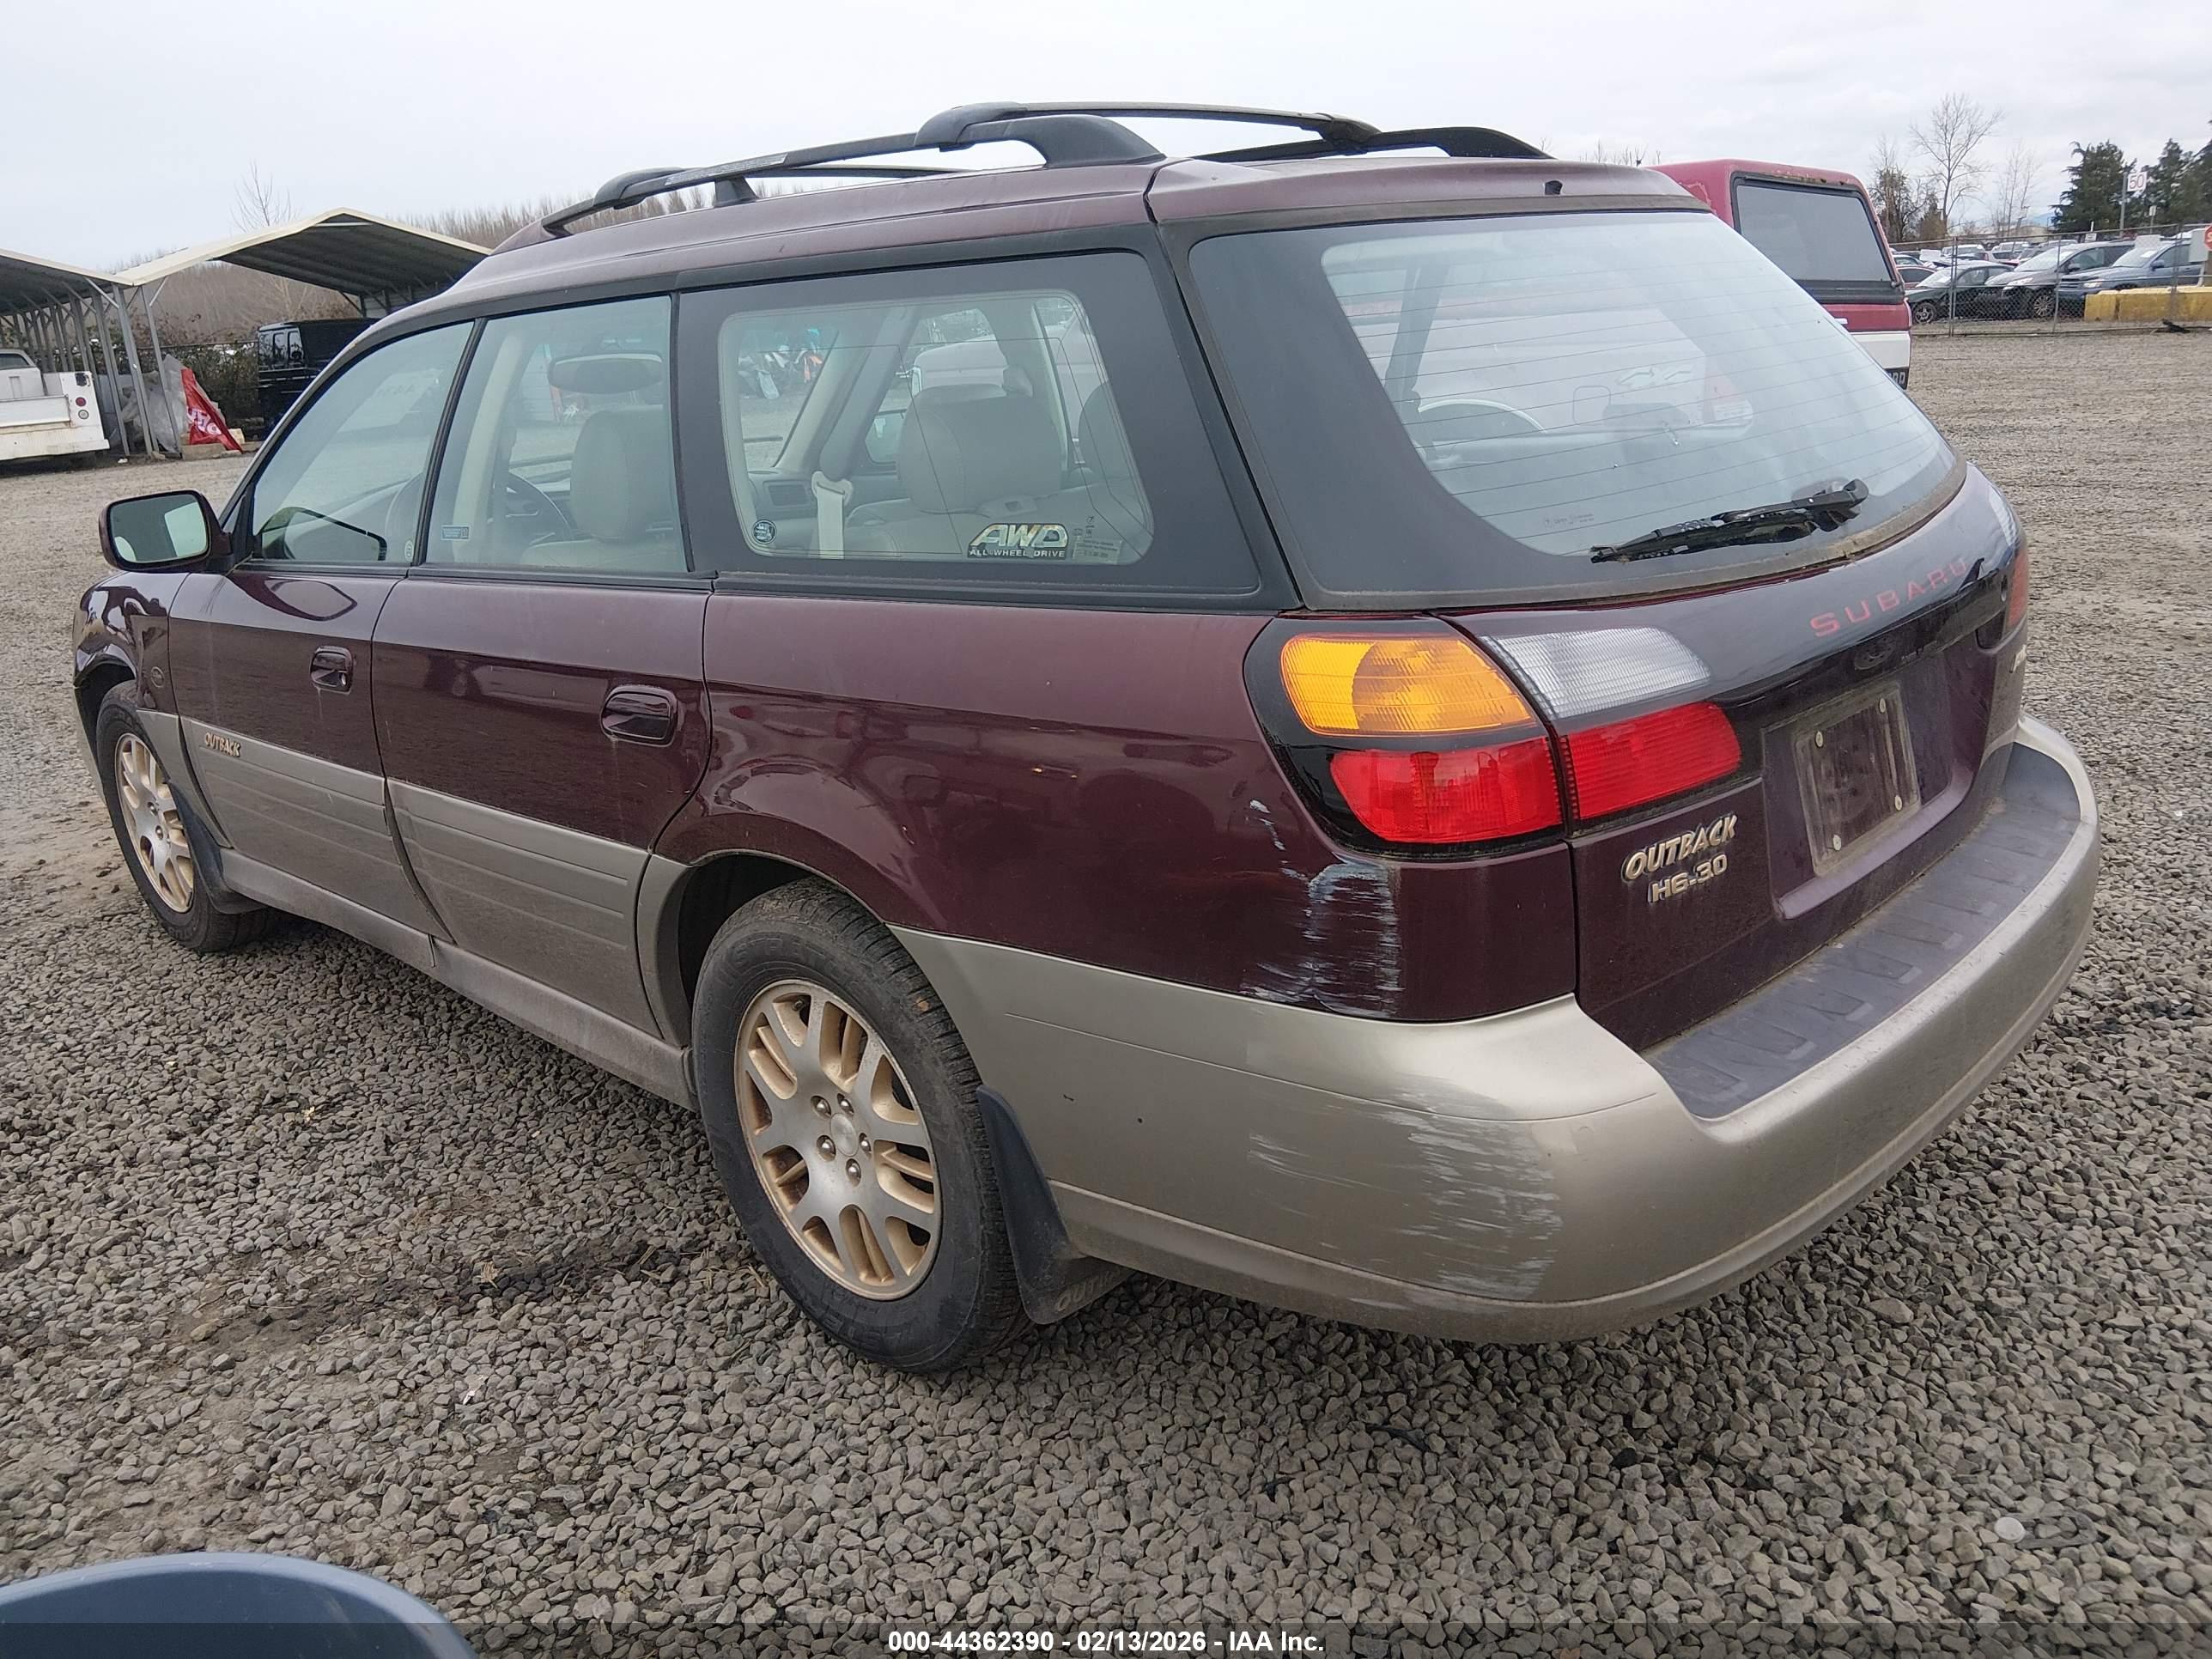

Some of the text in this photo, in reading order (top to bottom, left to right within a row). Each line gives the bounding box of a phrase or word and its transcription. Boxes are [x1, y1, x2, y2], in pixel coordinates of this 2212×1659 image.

[2130, 174, 2144, 189] 50
[970, 525, 1067, 547] AWD
[1810, 558, 1966, 637] SUBARU
[205, 732, 240, 757] OUTBACK
[1625, 815, 1737, 880] OUTBACK
